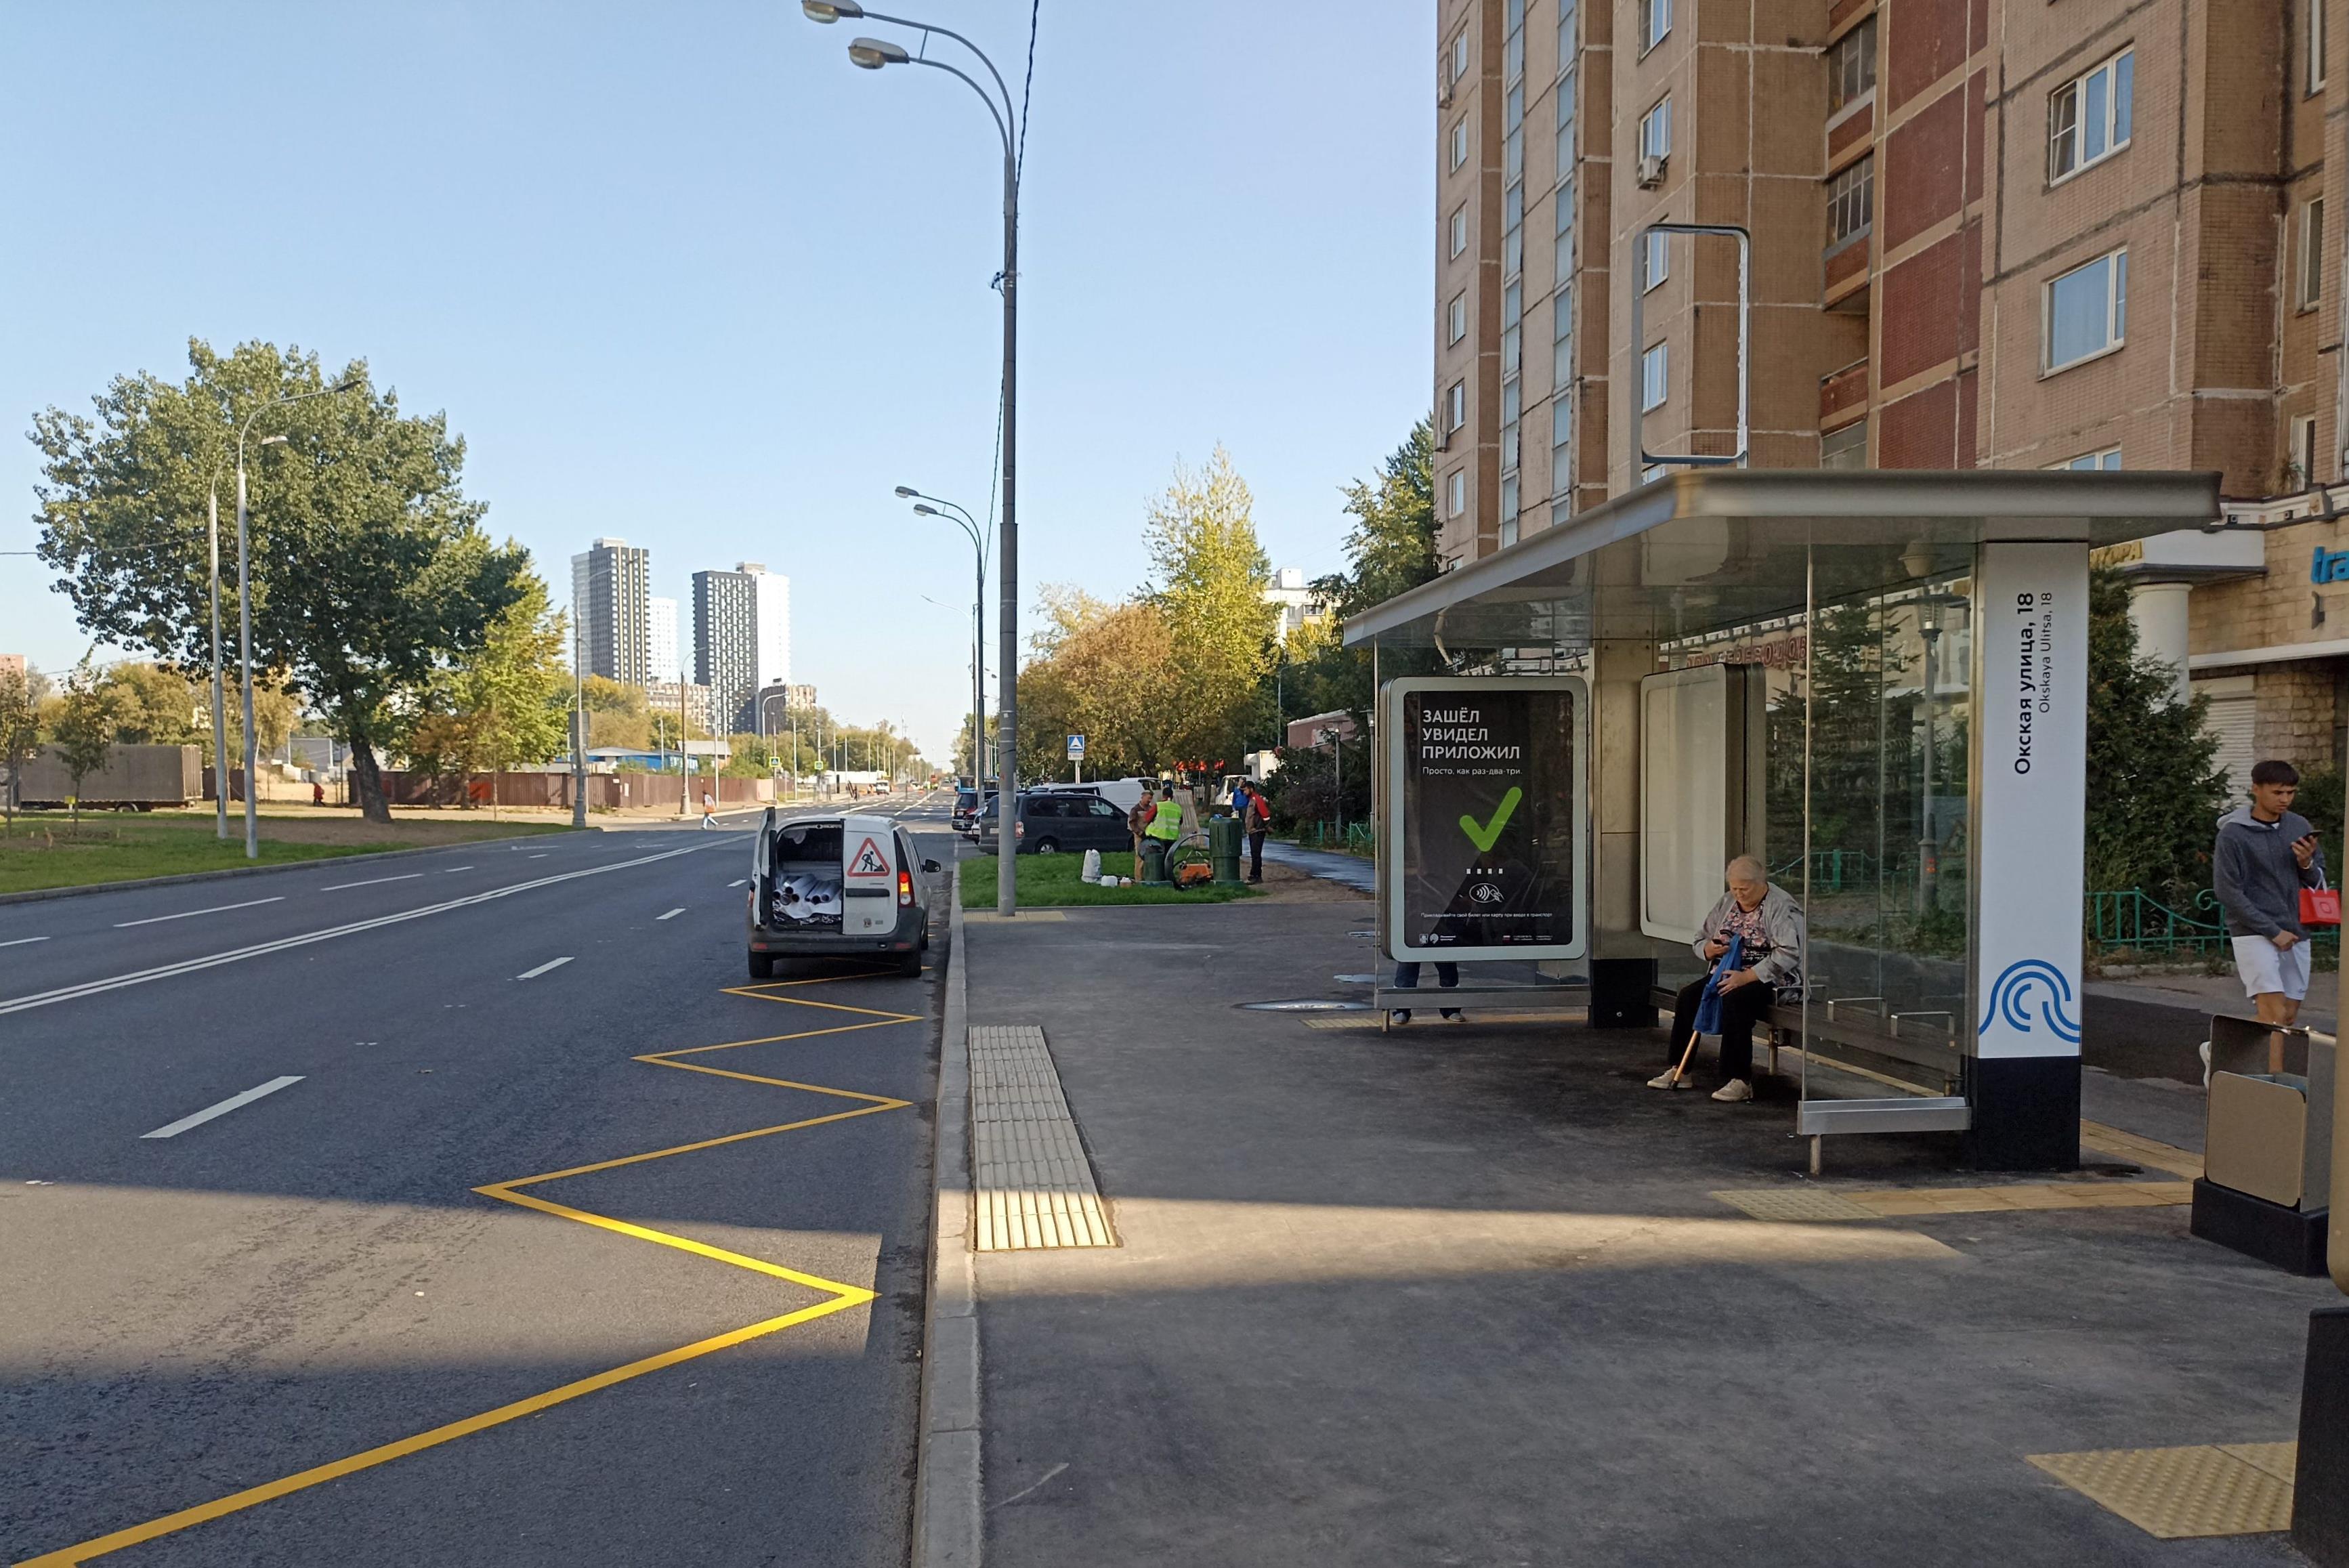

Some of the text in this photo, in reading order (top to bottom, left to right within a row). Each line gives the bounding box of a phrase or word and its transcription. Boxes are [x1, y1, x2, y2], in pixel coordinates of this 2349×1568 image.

[2039, 593, 2053, 713] Okskaya Ulitsa, 18
[2014, 593, 2036, 774] Окская улица, 18
[1422, 707, 1480, 723] ЗАШЁЛ
[1422, 728, 1488, 743] УВИДЕЛ
[1422, 746, 1520, 759] ПРИЛОЖИЛ
